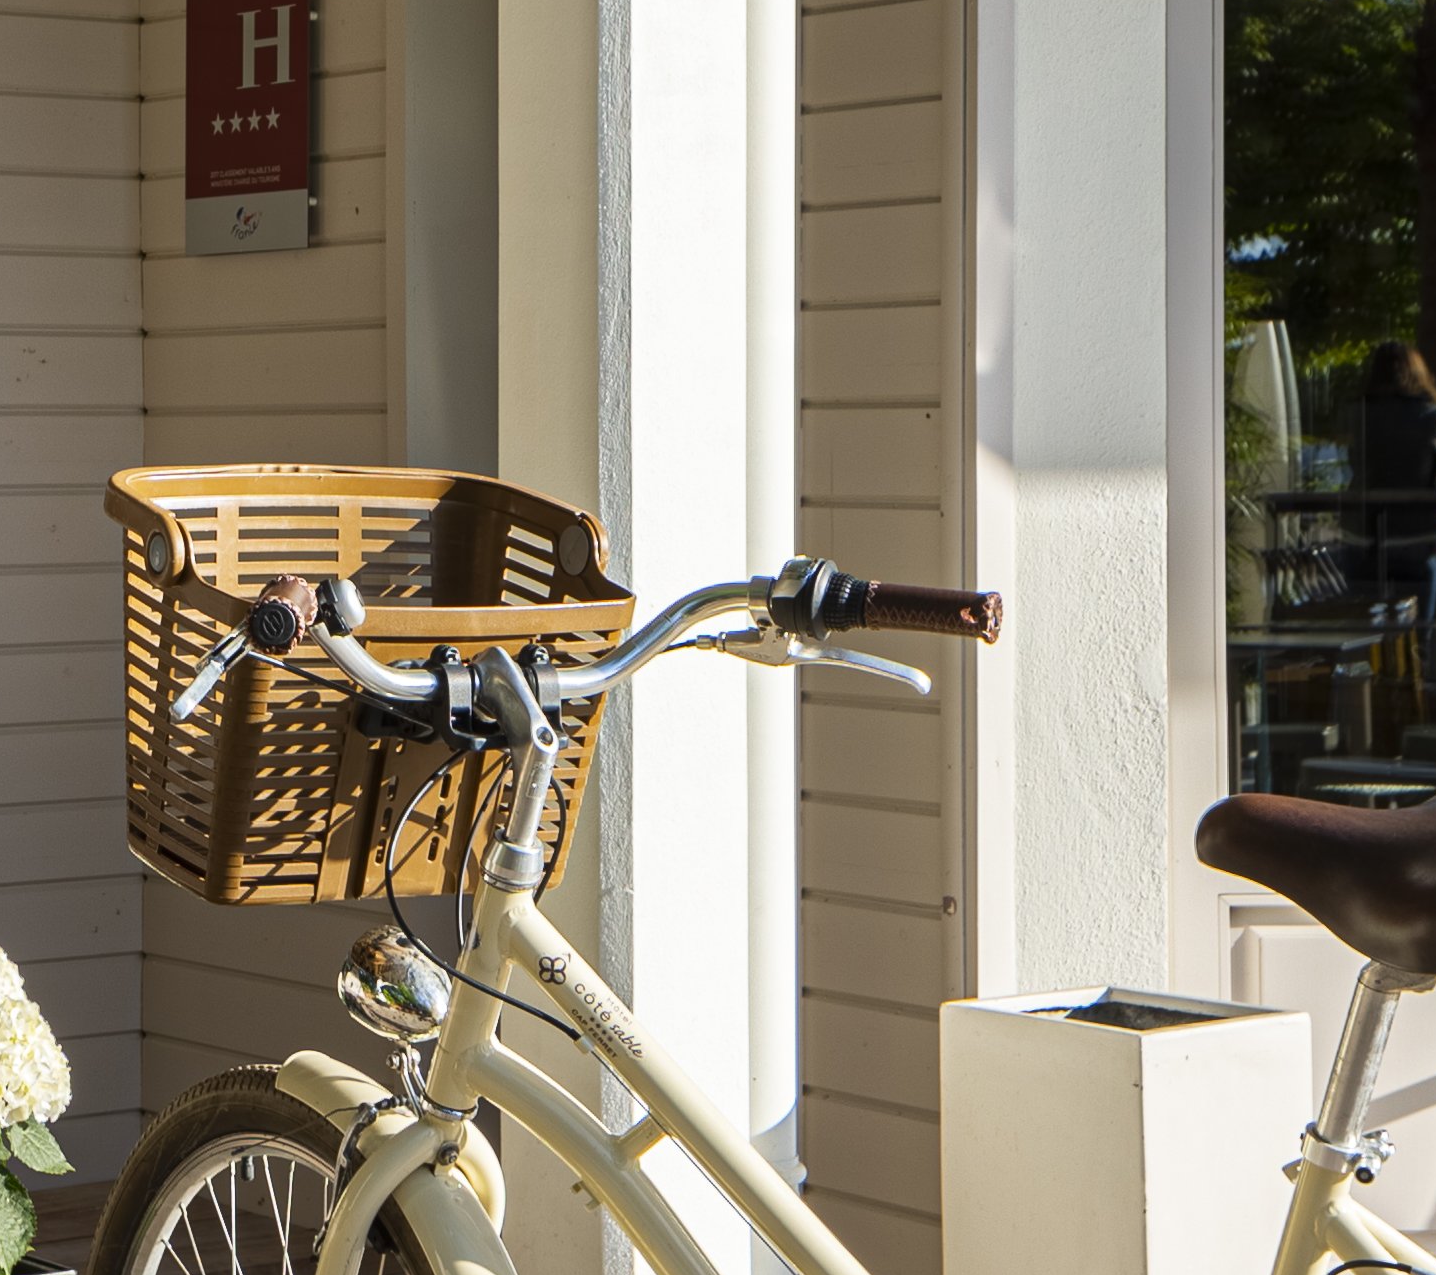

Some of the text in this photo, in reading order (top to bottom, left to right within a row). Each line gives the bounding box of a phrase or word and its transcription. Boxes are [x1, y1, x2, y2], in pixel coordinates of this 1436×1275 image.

[235, 3, 296, 91] H
[571, 1009, 619, 1059] CAP FERRET
[574, 983, 644, 1059] côté sable
